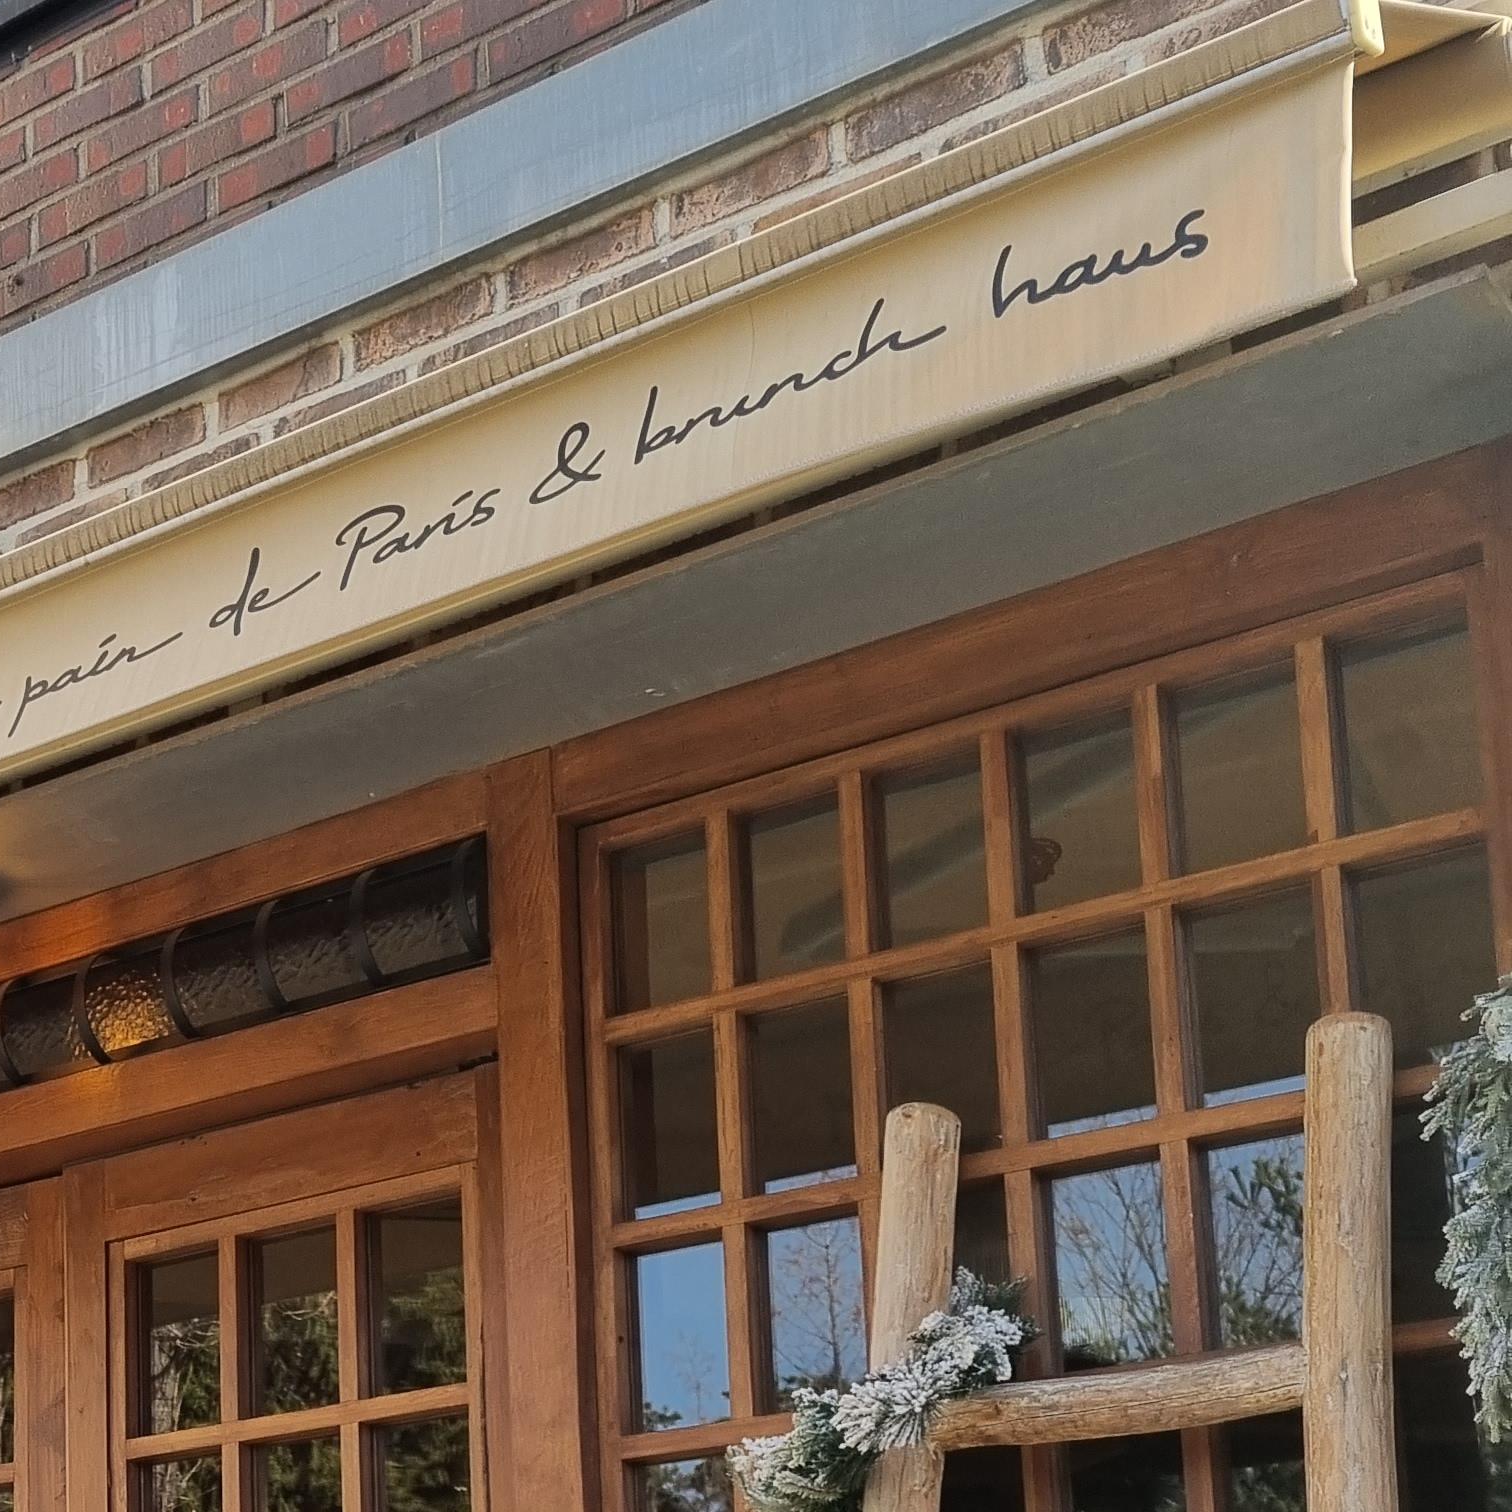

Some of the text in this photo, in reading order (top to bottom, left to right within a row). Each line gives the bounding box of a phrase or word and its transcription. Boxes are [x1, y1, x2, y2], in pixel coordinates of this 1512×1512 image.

[7, 632, 183, 739] pain
[209, 548, 321, 637] de
[335, 486, 500, 592] Paris
[528, 421, 606, 506] &
[633, 297, 947, 466] brunch
[992, 209, 1209, 319] haus
